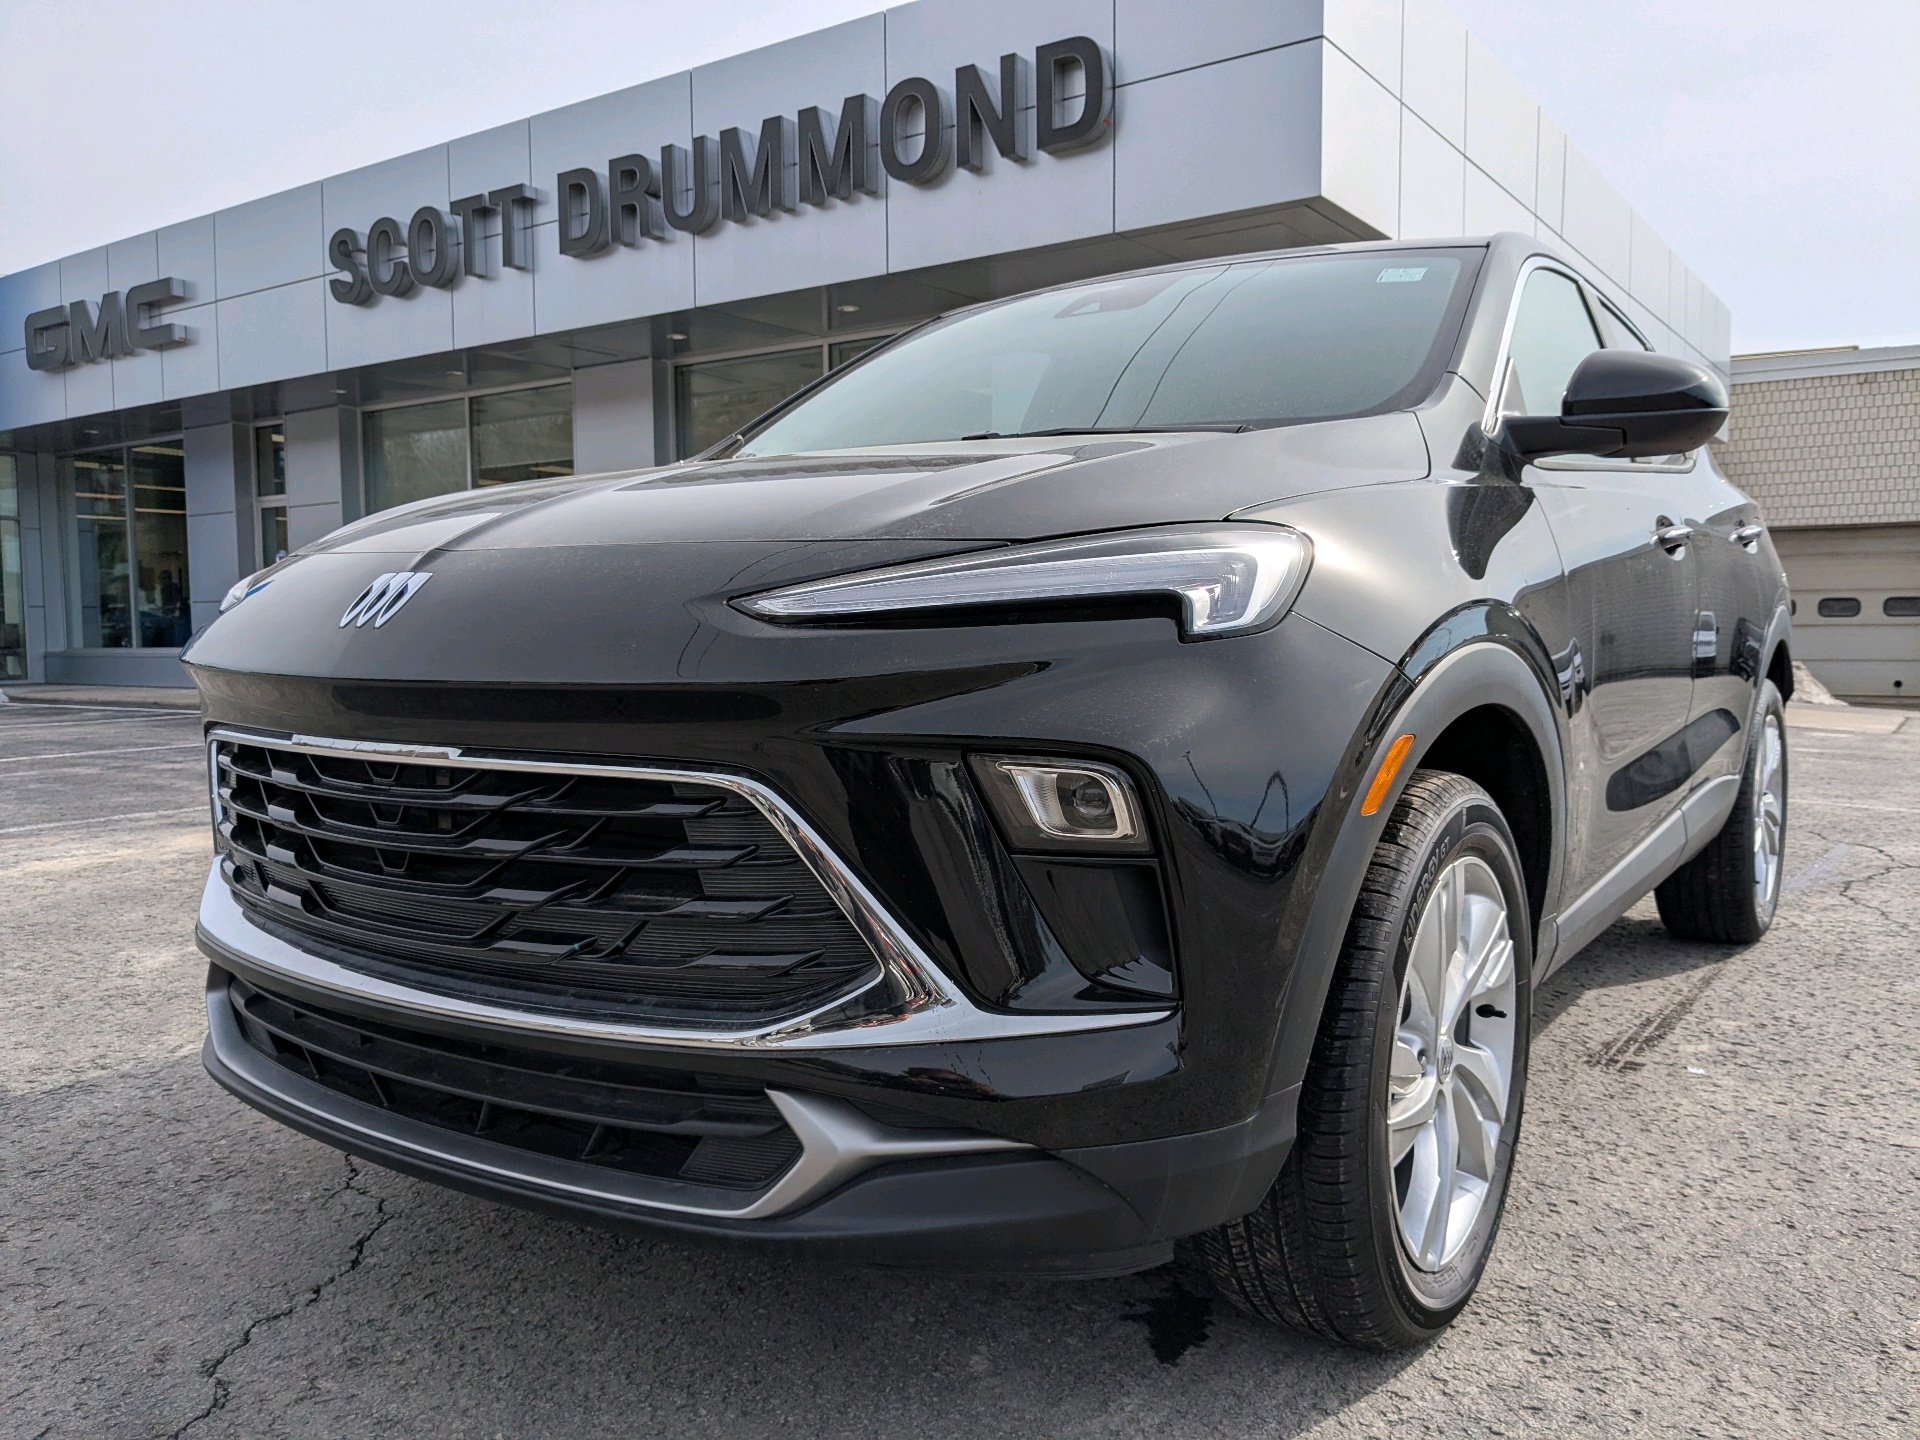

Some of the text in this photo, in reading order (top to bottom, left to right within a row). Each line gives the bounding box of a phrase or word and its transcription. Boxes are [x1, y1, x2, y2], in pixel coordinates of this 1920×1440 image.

[329, 36, 1109, 305] SCOTT DRUMMOND
[25, 277, 186, 370] GMC
